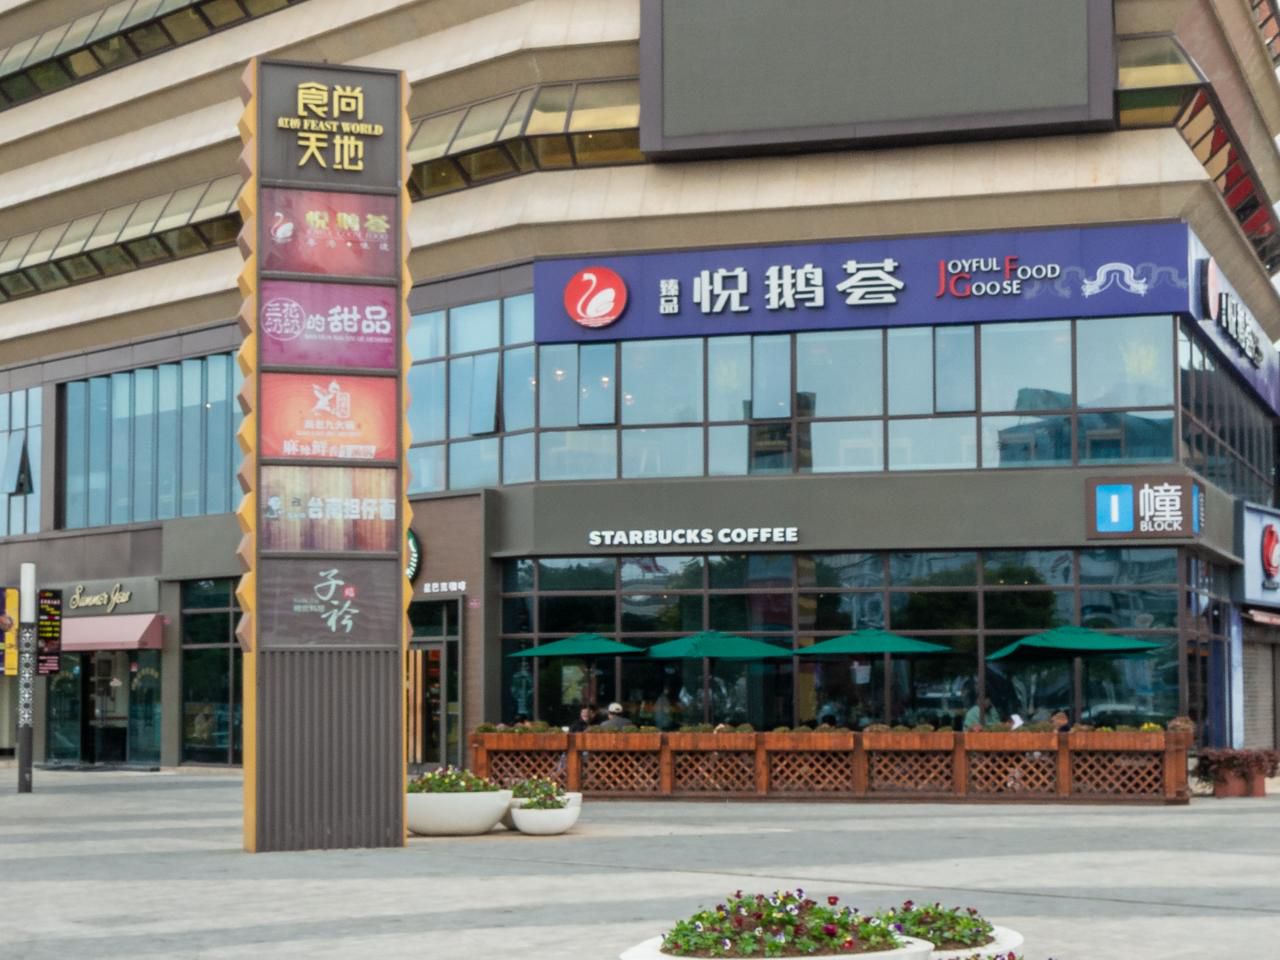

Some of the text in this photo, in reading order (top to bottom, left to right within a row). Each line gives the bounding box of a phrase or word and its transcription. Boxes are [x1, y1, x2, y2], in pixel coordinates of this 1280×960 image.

[297, 82, 365, 120] 食尚
[303, 118, 338, 133] FEAST
[341, 121, 384, 136] WORLD
[297, 131, 365, 171] 天地
[692, 258, 905, 314] 悦鹅荟
[935, 255, 1061, 299] JOYFUL FOOD
[949, 272, 1022, 299] GOOSE
[305, 305, 392, 335] 的甜品
[1138, 482, 1183, 522] 幢
[588, 527, 799, 546] STARBUCKS COFFEE
[1140, 521, 1183, 532] BLOCK
